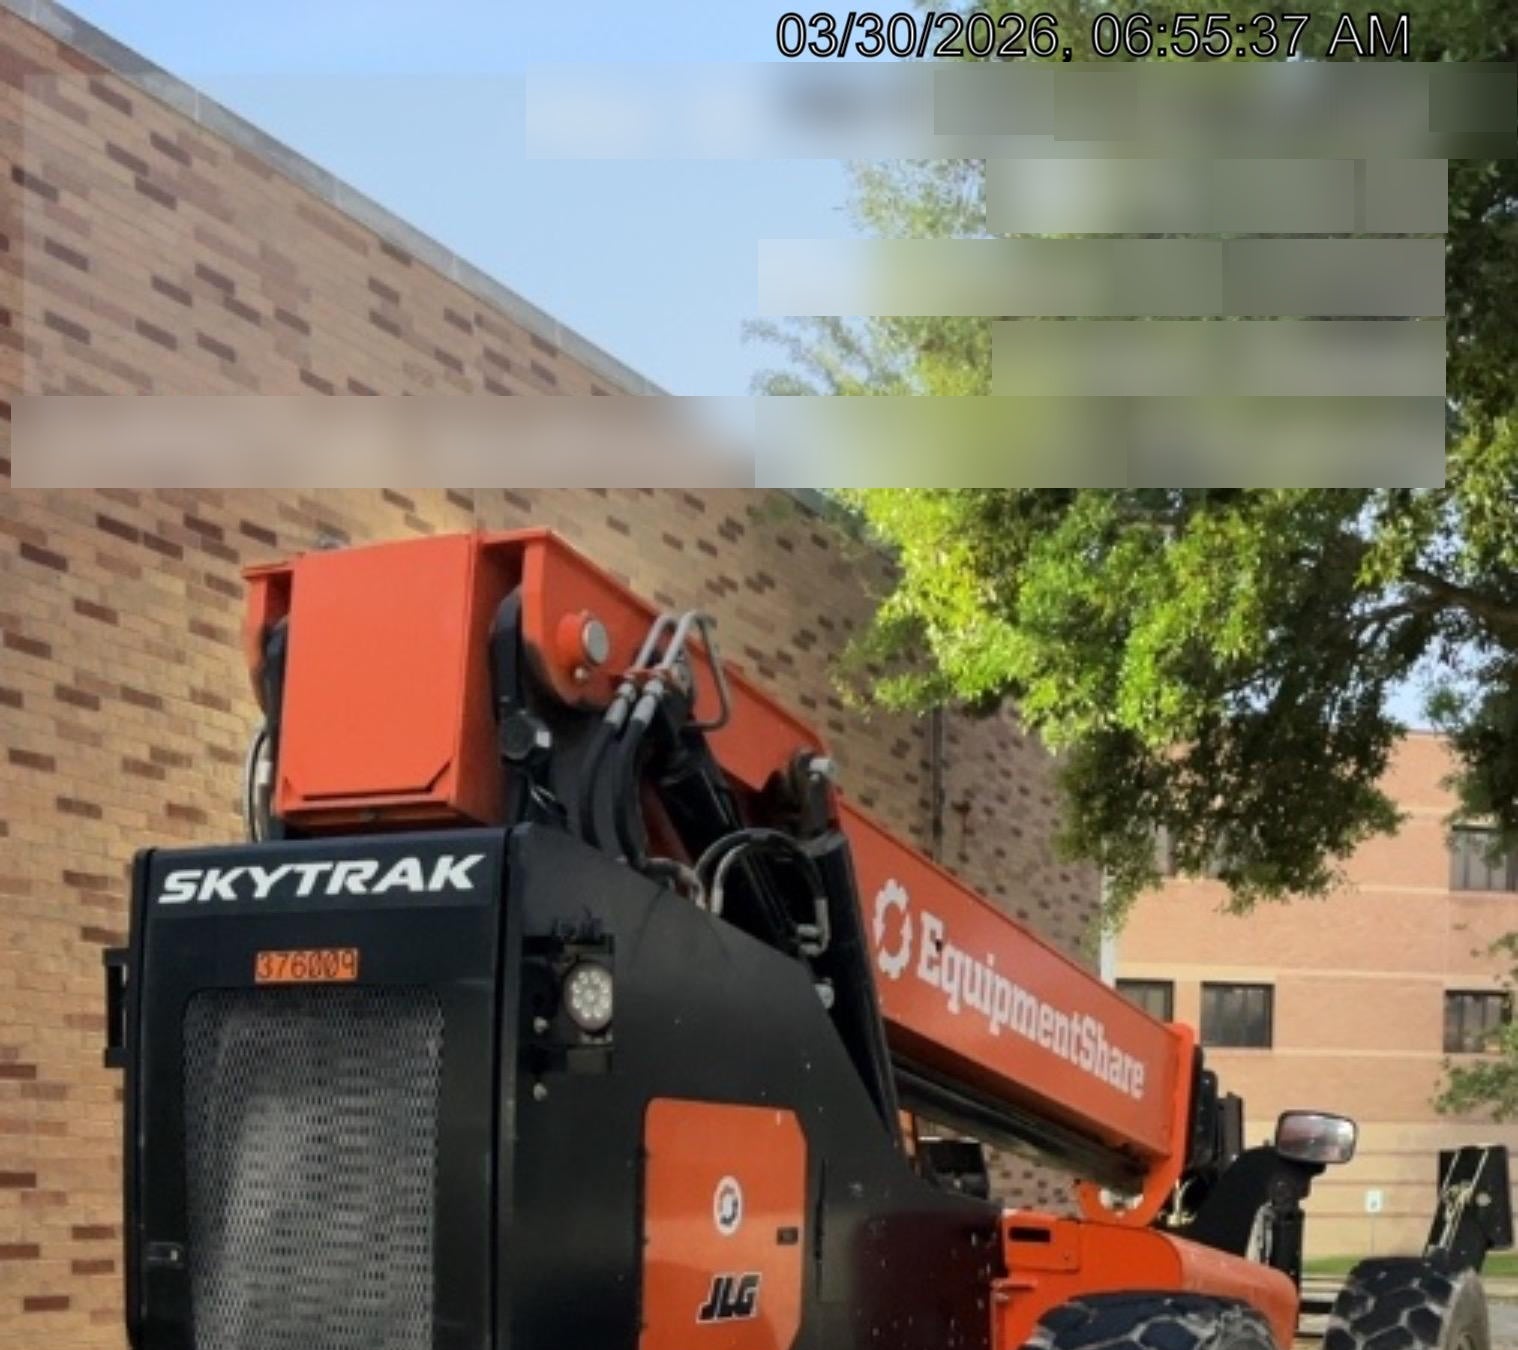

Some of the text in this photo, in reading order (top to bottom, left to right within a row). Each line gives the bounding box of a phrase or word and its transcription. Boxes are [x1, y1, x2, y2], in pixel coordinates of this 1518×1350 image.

[158, 854, 486, 904] SKYTRAK
[258, 951, 356, 979] 376009
[917, 910, 1145, 1098] EquipmentShare
[696, 1271, 761, 1323] JLG
